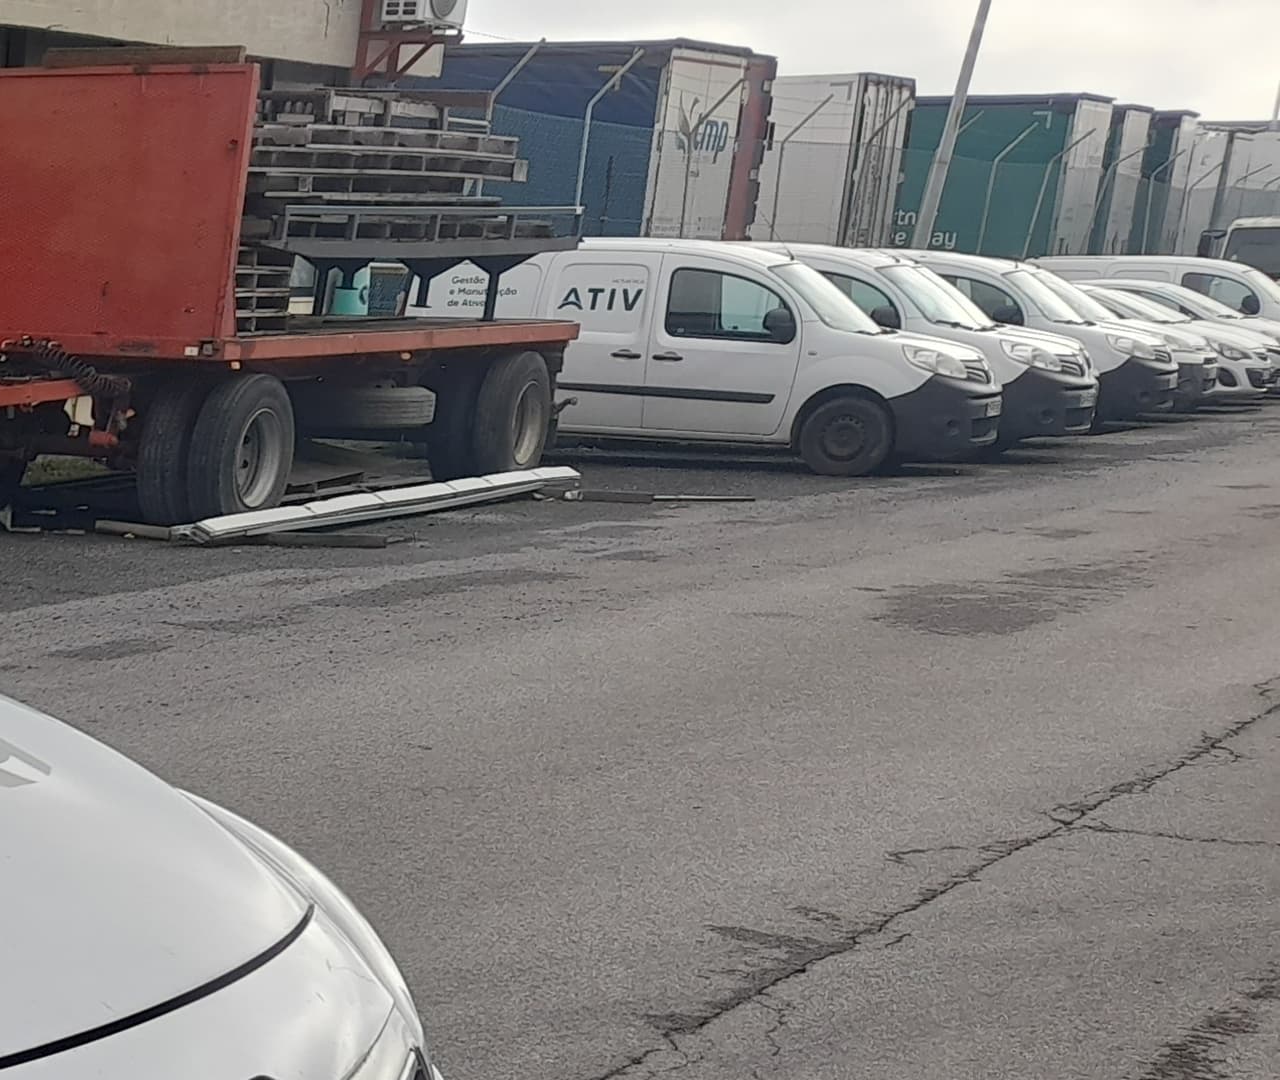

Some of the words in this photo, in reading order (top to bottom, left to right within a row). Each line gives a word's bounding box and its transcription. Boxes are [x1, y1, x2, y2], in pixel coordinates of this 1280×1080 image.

[451, 276, 486, 284] Gestão
[457, 287, 518, 296] Manutção
[461, 299, 486, 307] Ativo
[557, 287, 644, 311] ATIV
